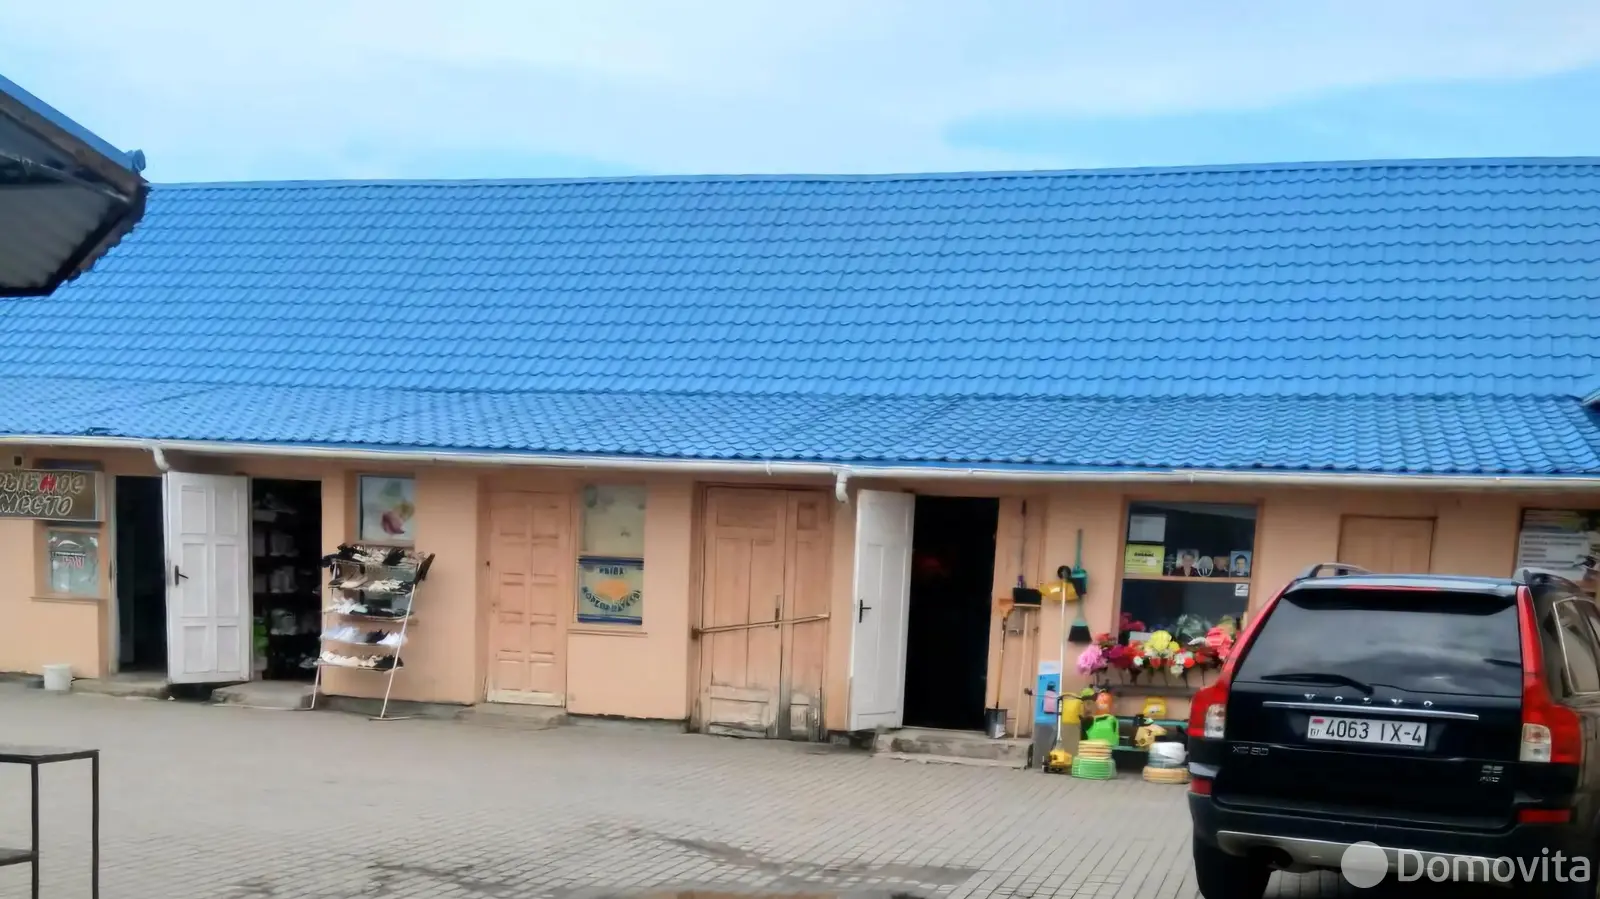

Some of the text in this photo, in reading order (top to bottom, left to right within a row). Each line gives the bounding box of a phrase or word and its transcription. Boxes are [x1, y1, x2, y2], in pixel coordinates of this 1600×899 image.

[1304, 693, 1434, 708] VOLVO
[1325, 719, 1370, 740] 4063
[1379, 722, 1422, 744] IX-4
